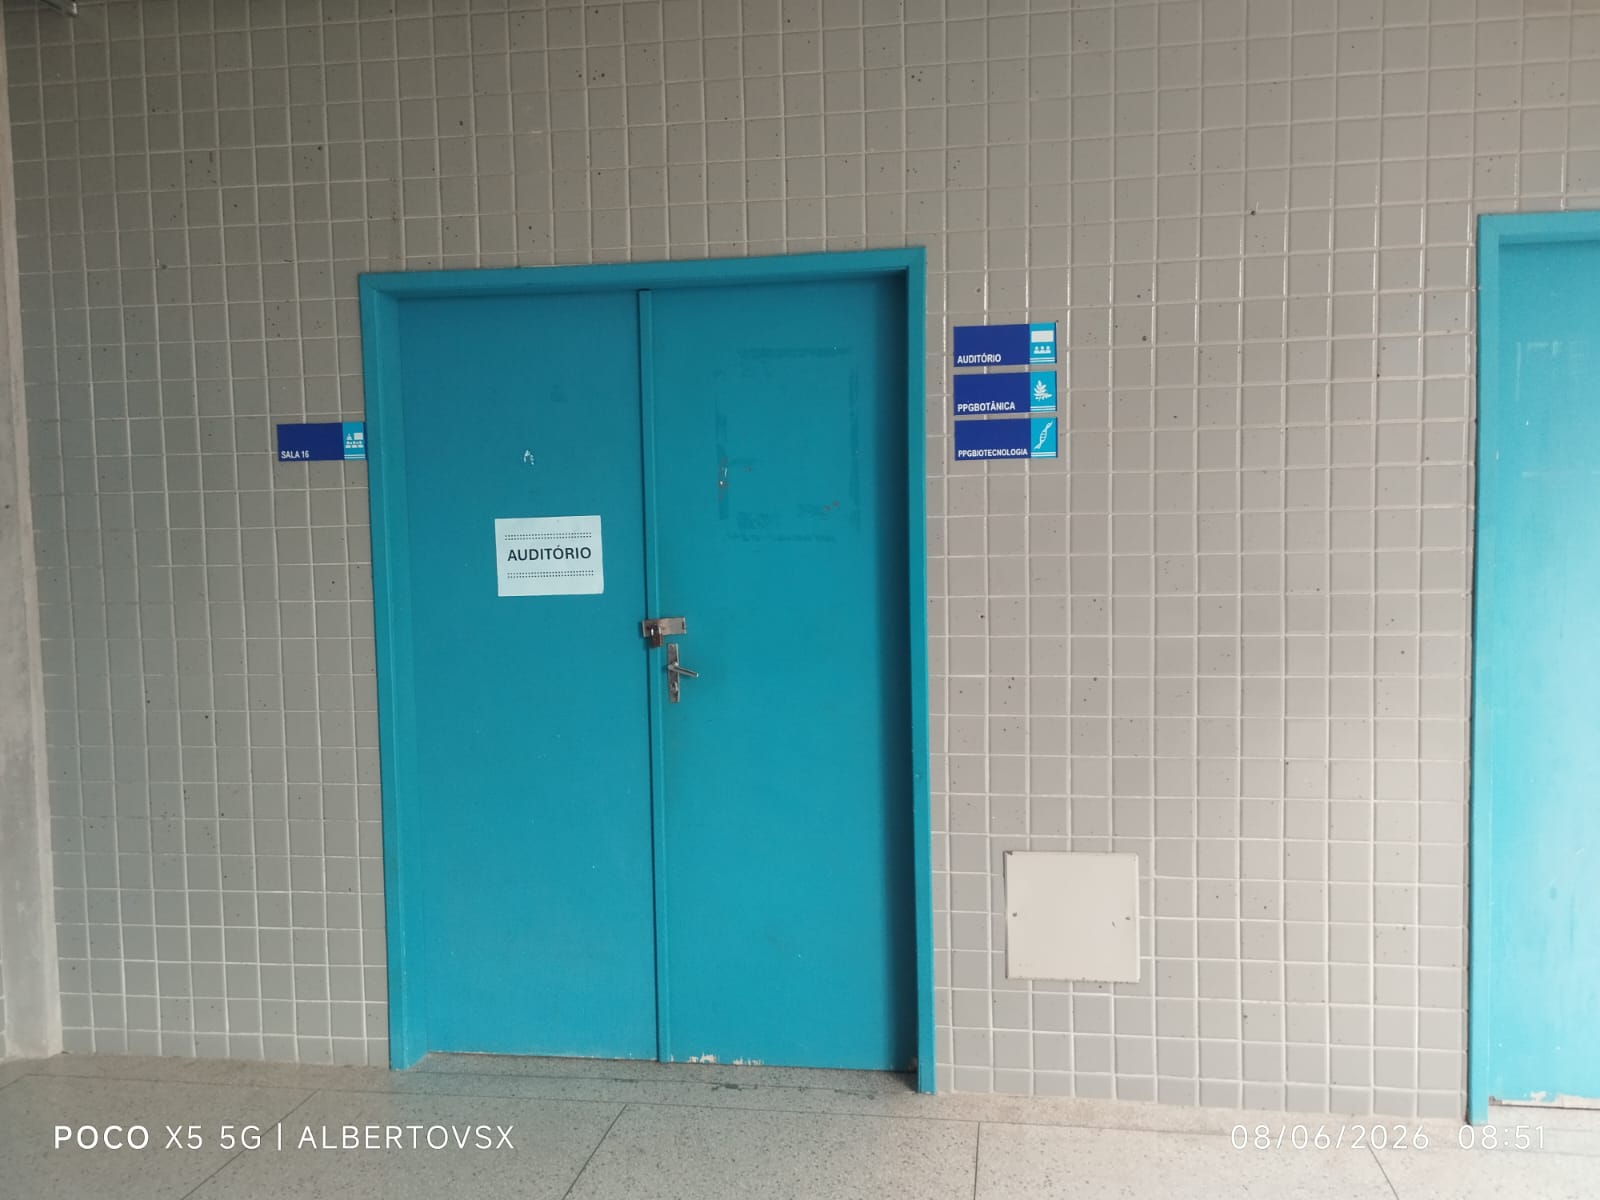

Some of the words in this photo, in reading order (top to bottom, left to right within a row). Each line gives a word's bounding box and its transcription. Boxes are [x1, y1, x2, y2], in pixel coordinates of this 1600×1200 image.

[957, 353, 1002, 364] AUDITÓRIO
[957, 401, 1016, 412] PPGBOTÂNICA
[281, 450, 300, 459] SALA
[957, 448, 1028, 457] PPGBIOTECNOLOGIA
[507, 545, 592, 561] AUDITÓRIO
